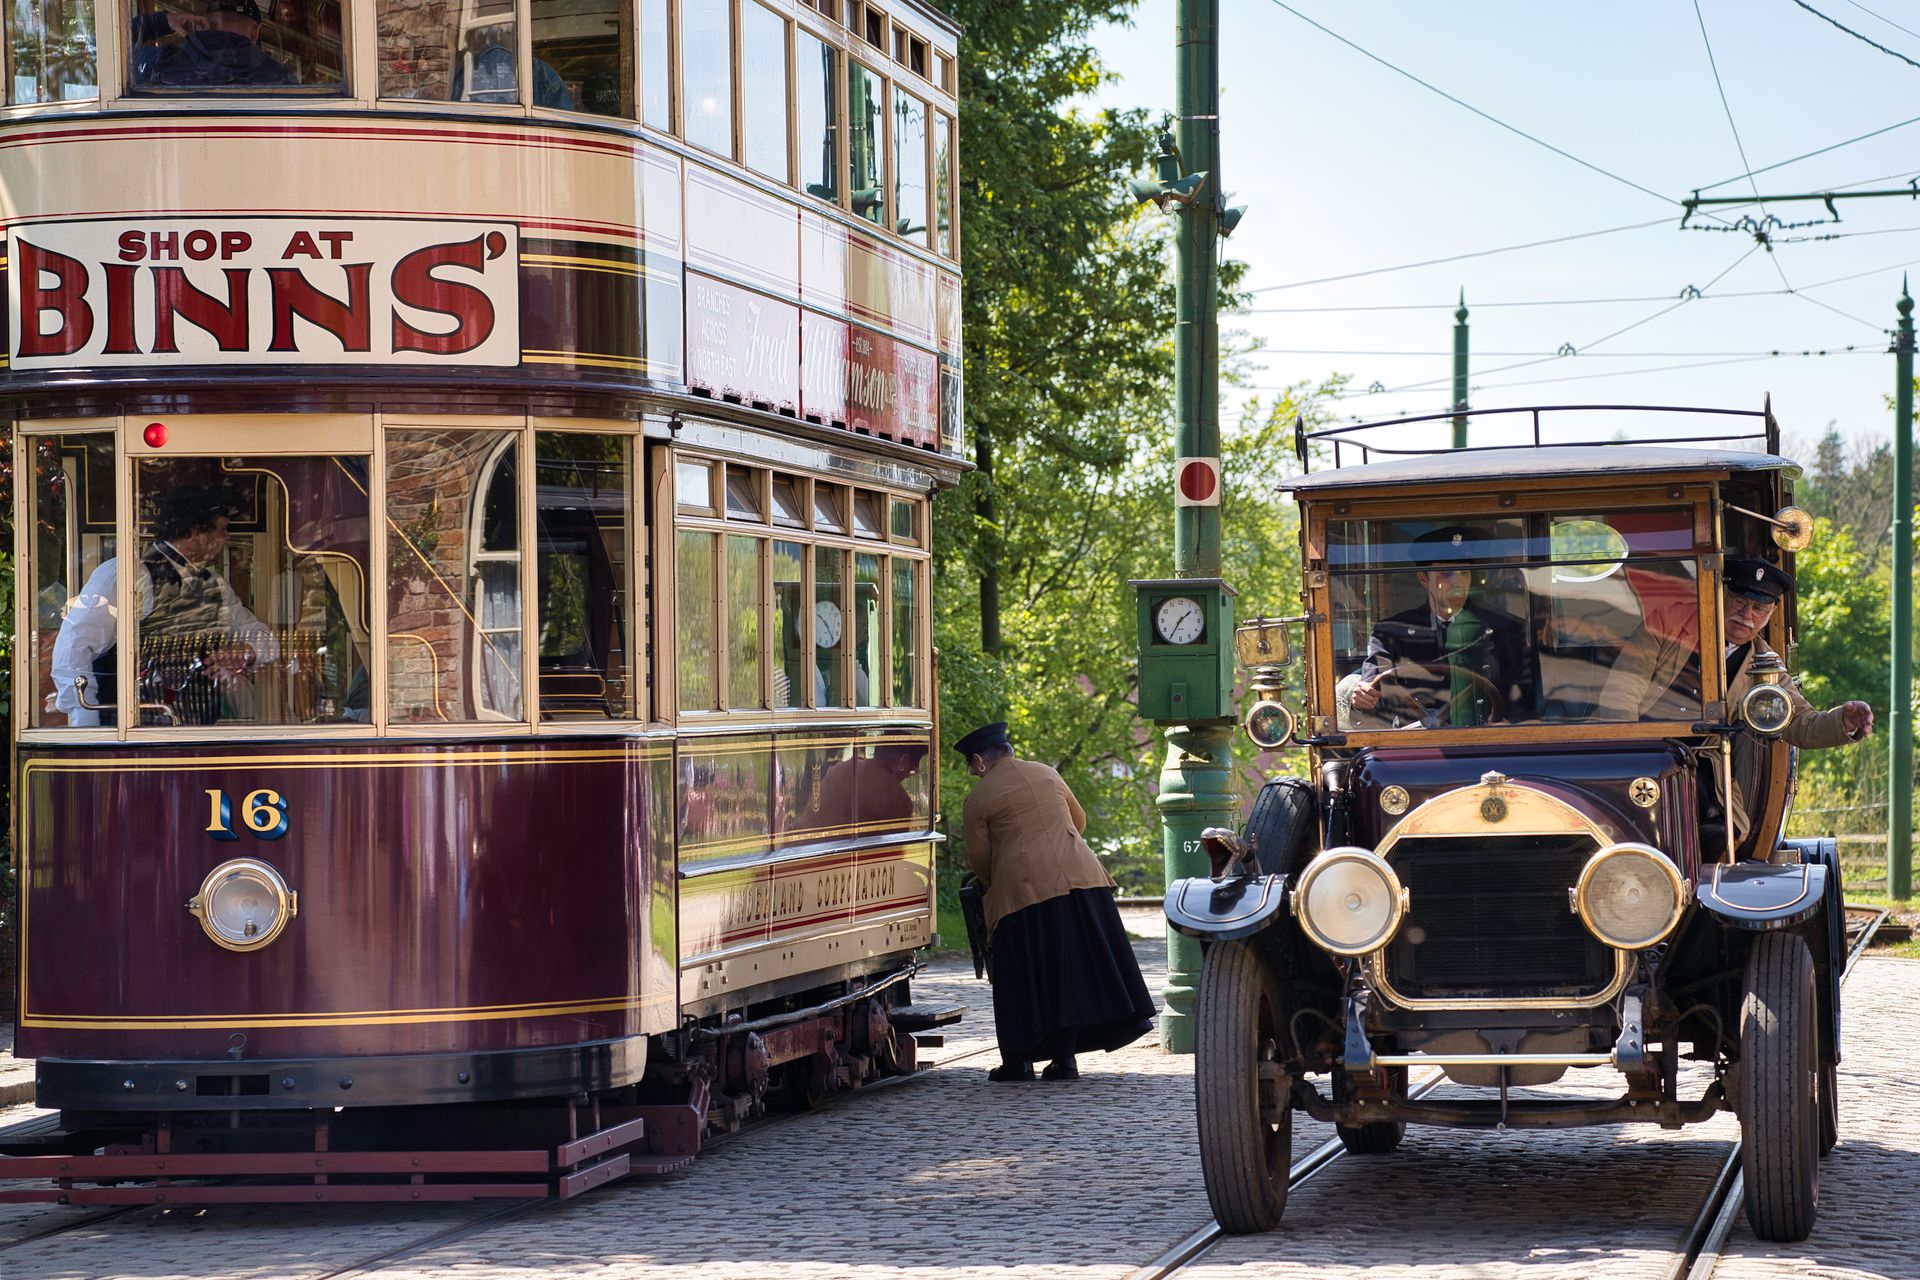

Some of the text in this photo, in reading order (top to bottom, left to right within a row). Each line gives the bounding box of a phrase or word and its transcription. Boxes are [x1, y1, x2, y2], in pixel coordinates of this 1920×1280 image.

[118, 229, 354, 262] SHOP AT
[15, 230, 507, 358] BINNS'
[697, 285, 731, 316] BRANCHES
[701, 318, 727, 346] ACROSS
[745, 300, 792, 384] Fred
[697, 348, 737, 378] NORTH EAST
[204, 788, 285, 836] 16
[1183, 840, 1201, 853] 67
[816, 865, 896, 908] CORPORATION
